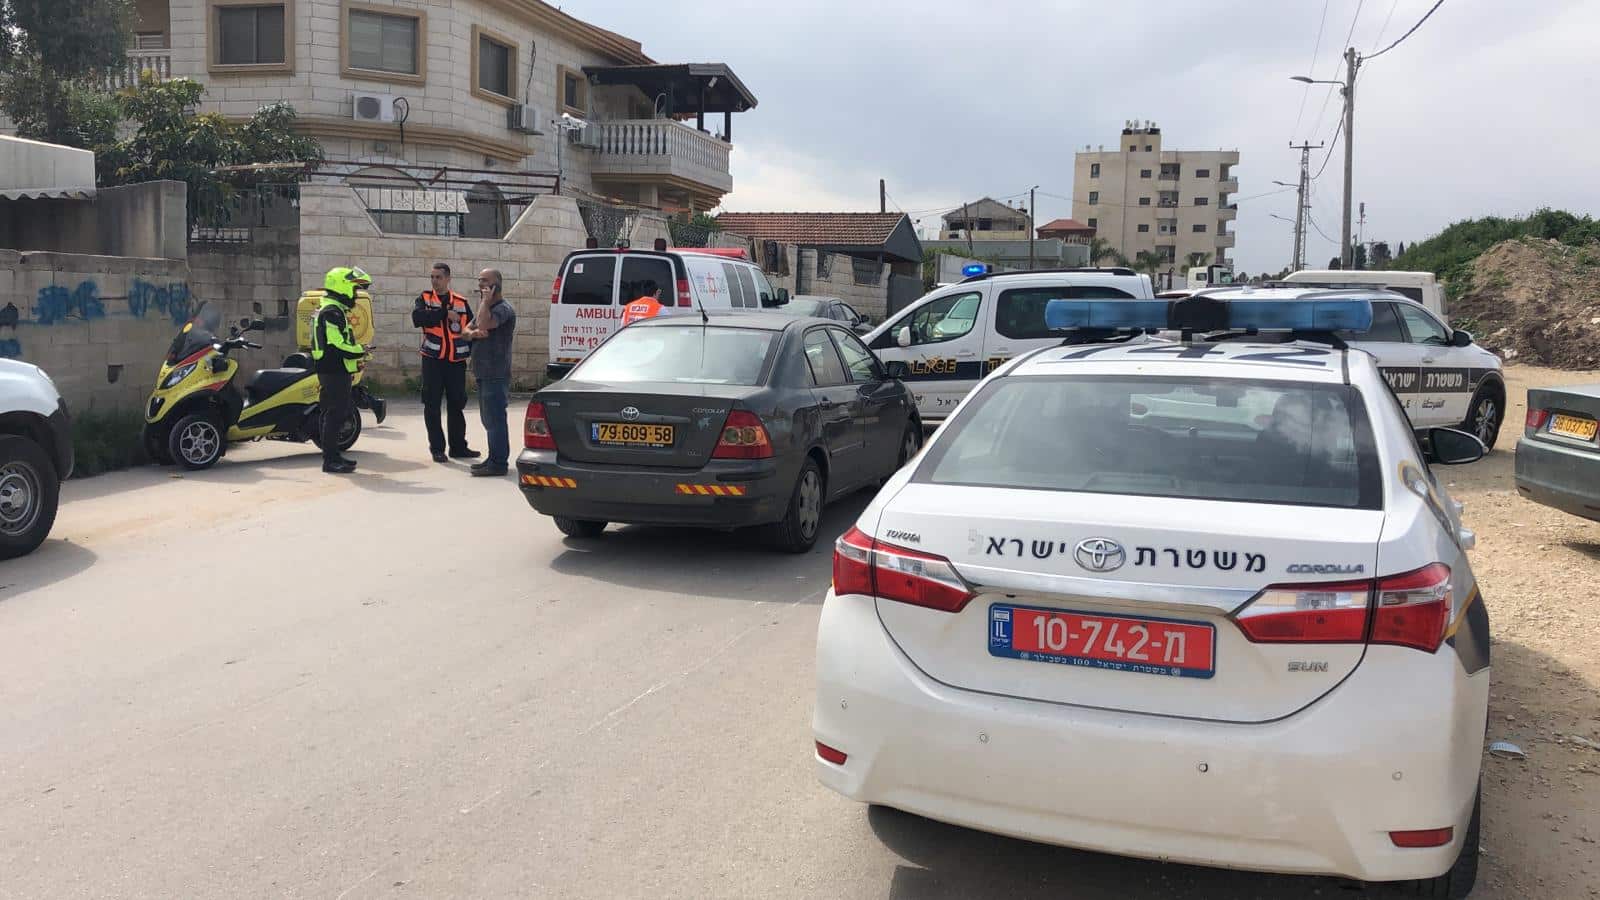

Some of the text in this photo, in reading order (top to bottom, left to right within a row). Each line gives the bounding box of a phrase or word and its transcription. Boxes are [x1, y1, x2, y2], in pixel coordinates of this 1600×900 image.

[581, 326, 592, 334] דוד
[1426, 373, 1463, 388] משטרת
[886, 529, 921, 543] TOYOTA
[1134, 546, 1267, 573] משטרת
[1286, 564, 1365, 574] COROLLA
[995, 621, 1007, 637] IL
[1073, 658, 1090, 666] 100
[1288, 662, 1328, 672] SUN
[1132, 665, 1167, 675] משטרת
